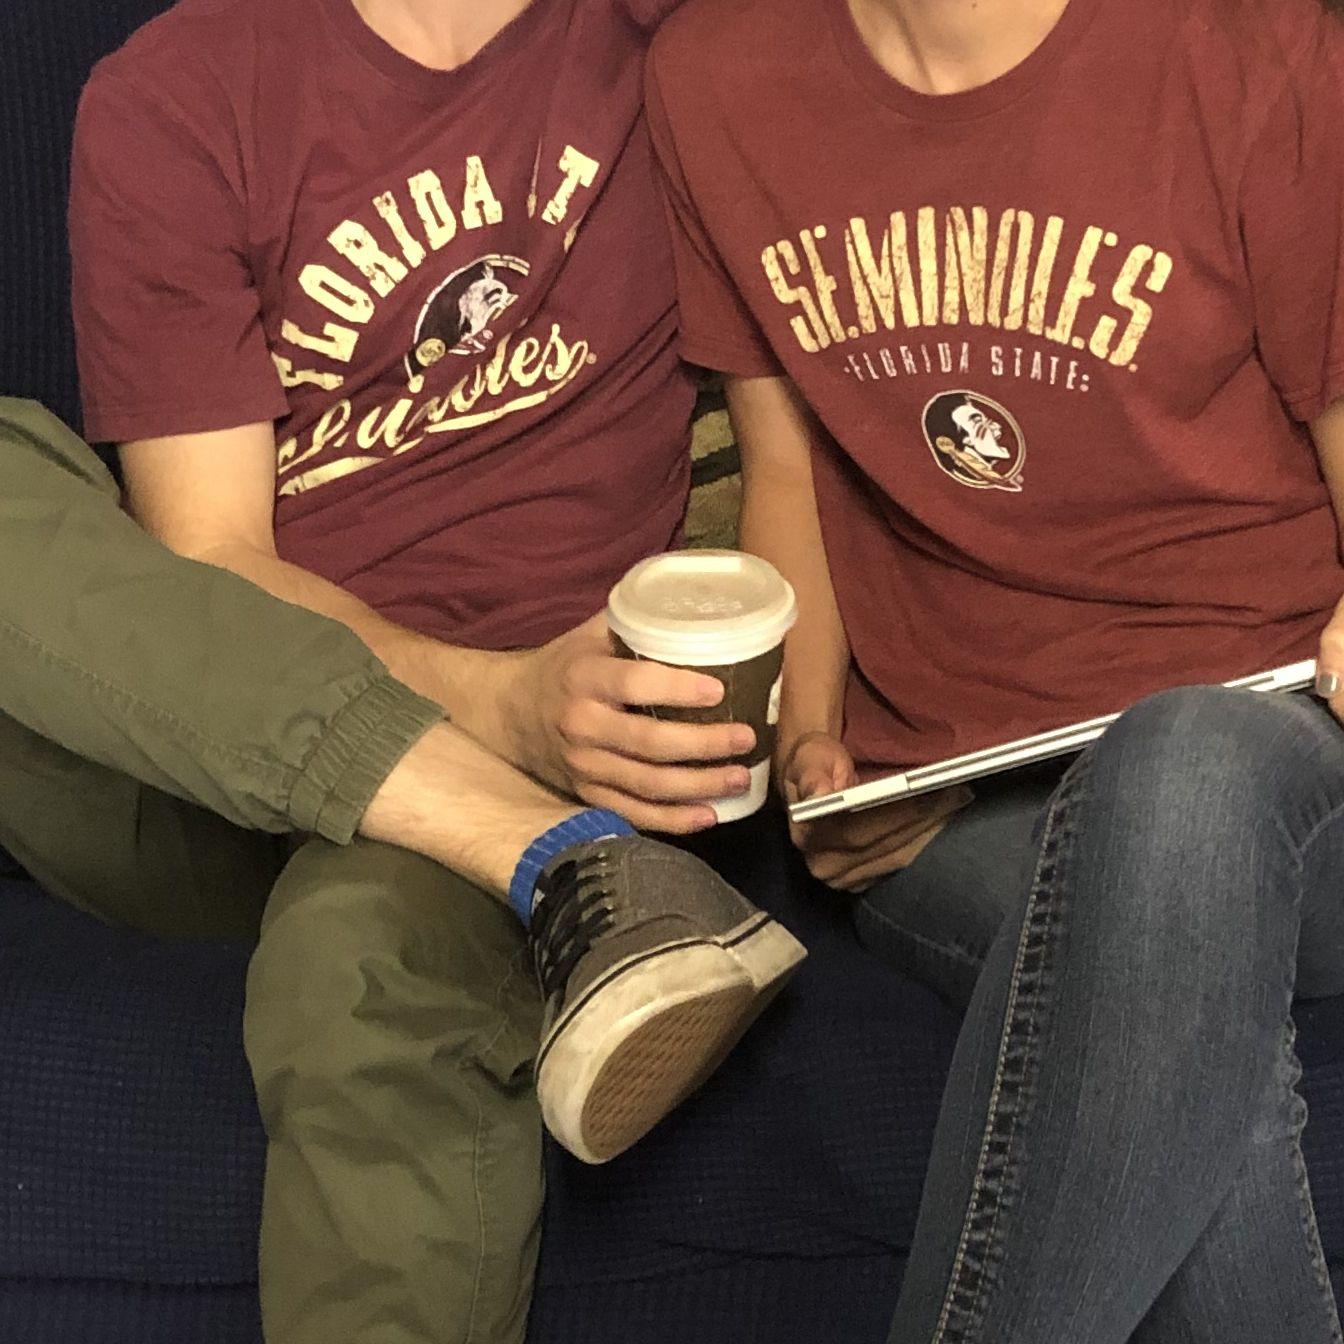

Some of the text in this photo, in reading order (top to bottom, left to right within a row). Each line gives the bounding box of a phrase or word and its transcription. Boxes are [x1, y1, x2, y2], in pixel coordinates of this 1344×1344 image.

[270, 155, 503, 391] FLORIDA
[761, 206, 1173, 368] SEMINOLES
[846, 341, 1079, 390] FLORIDA STATE
